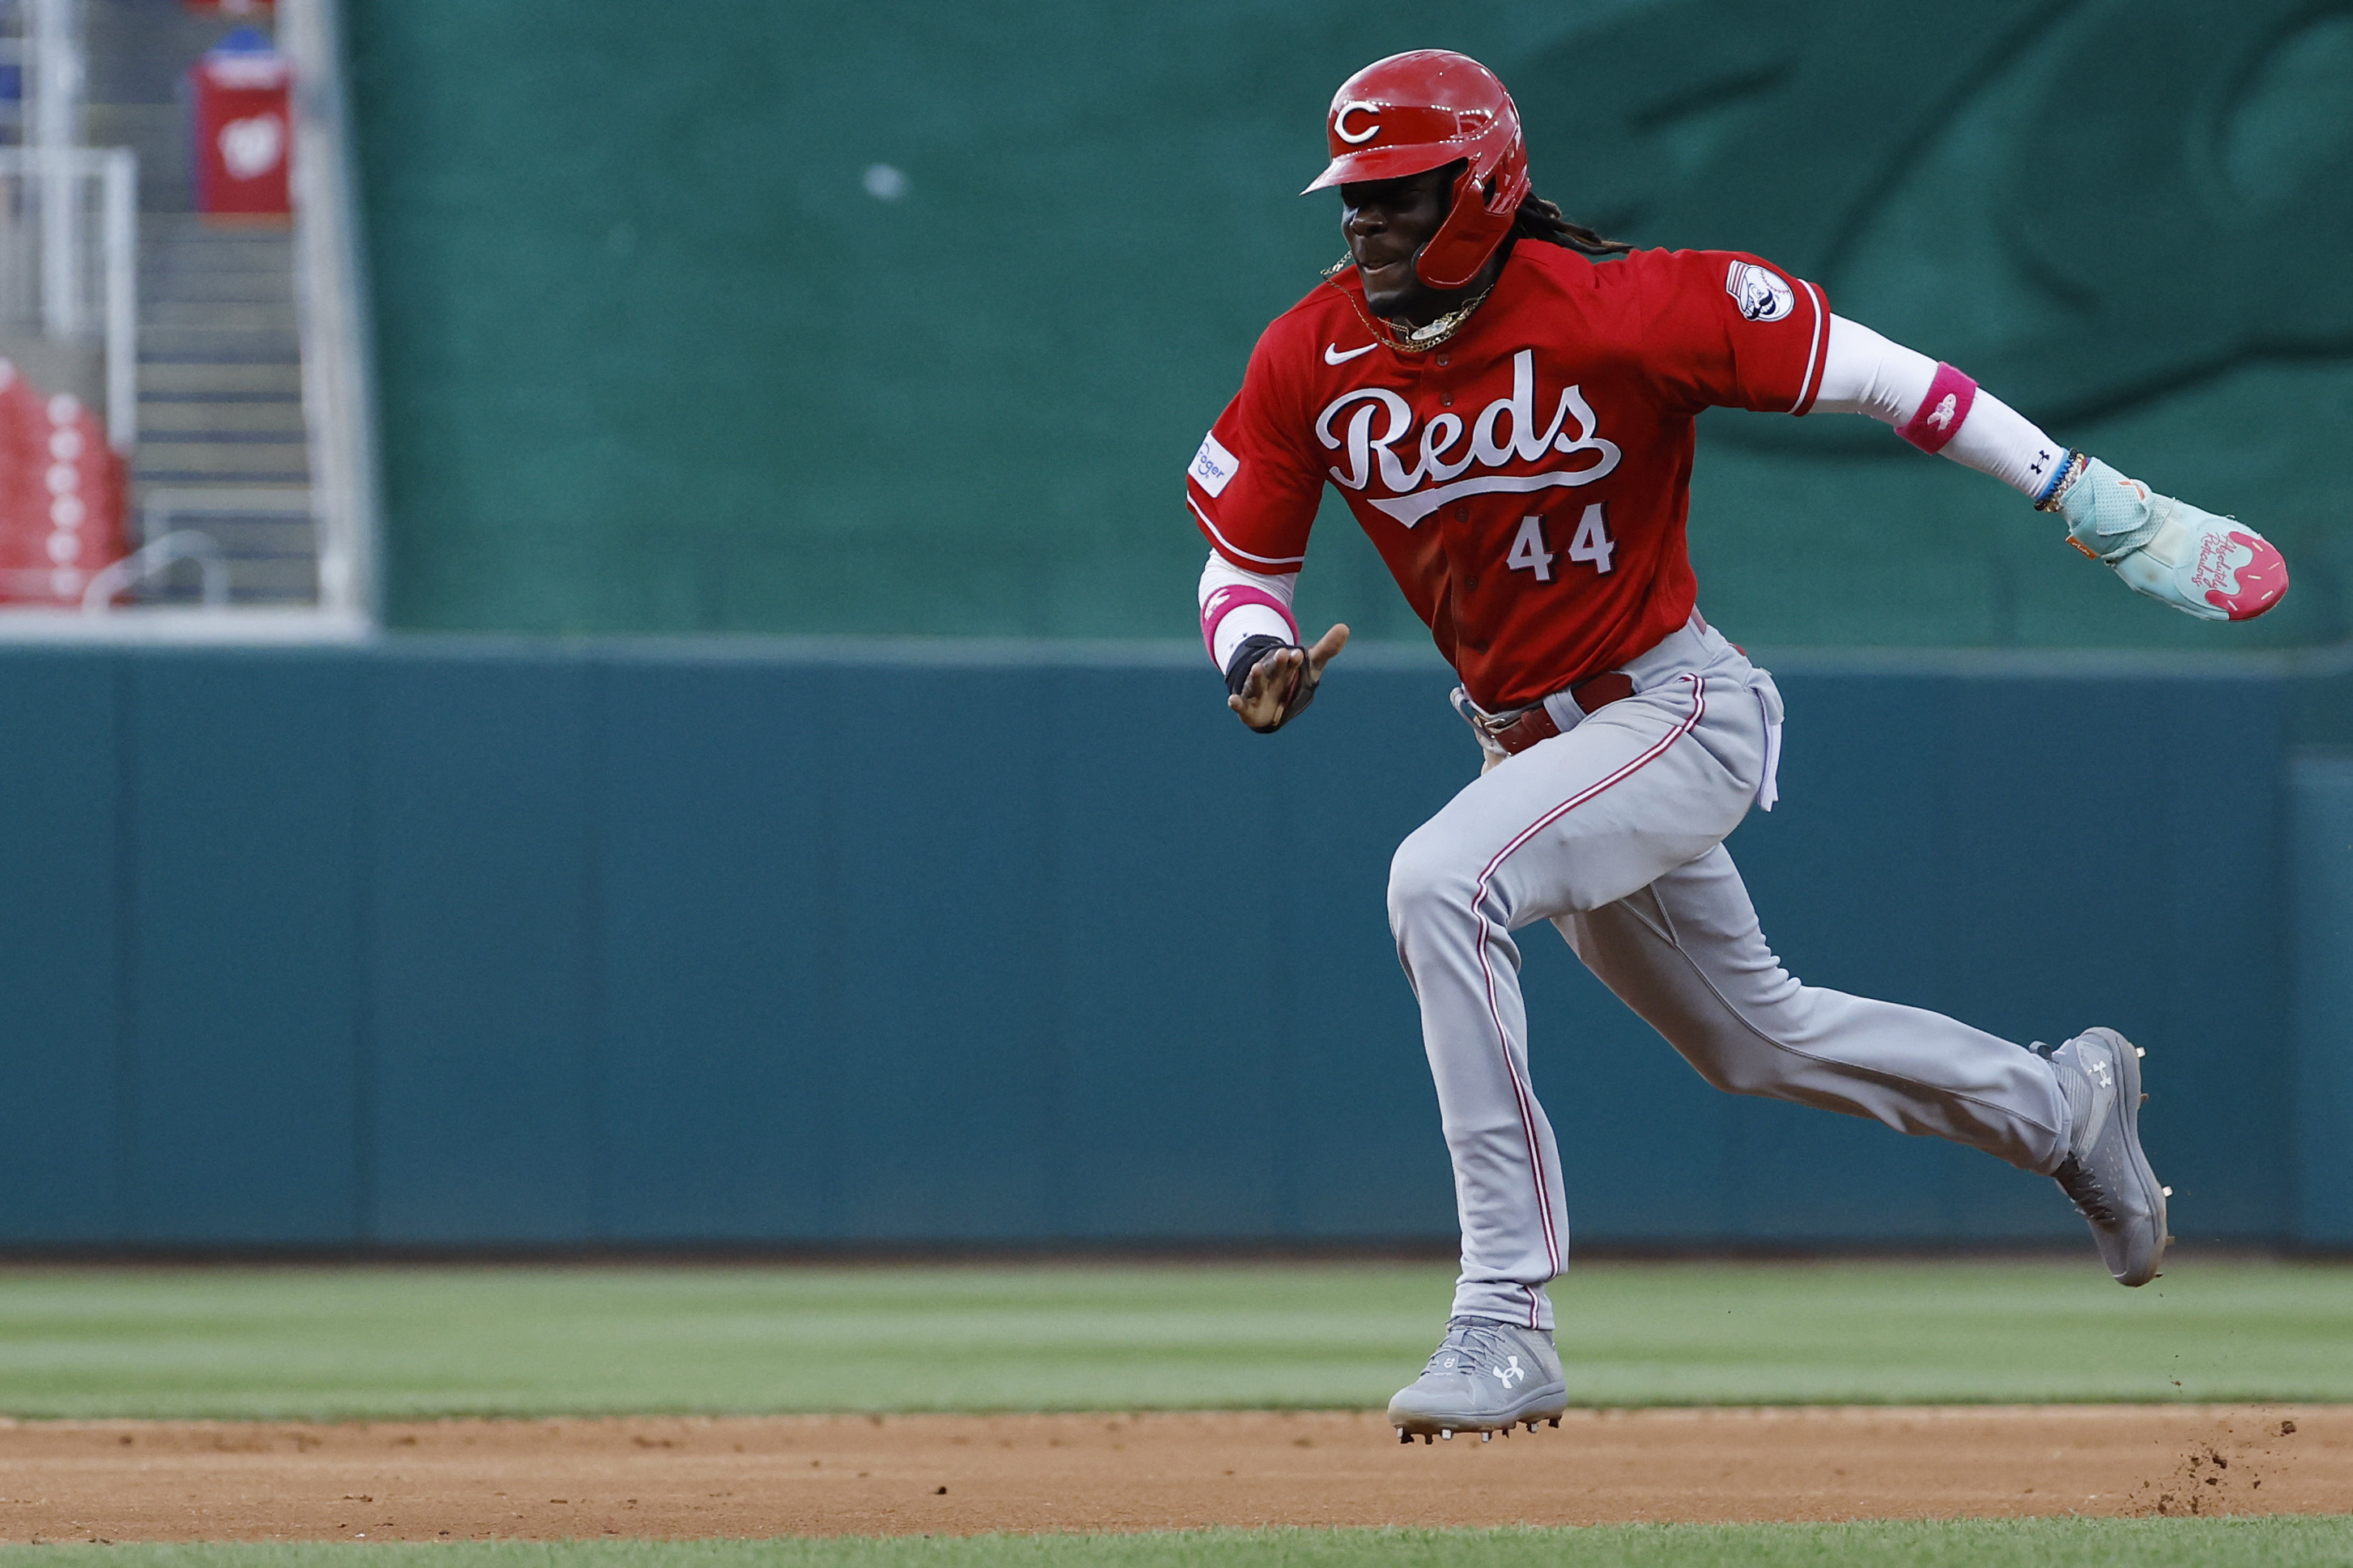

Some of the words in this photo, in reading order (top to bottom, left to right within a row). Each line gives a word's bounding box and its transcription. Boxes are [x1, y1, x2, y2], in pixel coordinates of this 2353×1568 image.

[1334, 101, 1381, 144] C
[1316, 349, 1621, 495] Reds
[1197, 442, 1225, 478] roger
[1507, 501, 1615, 582] 44
[2203, 533, 2236, 589] Absolutely
